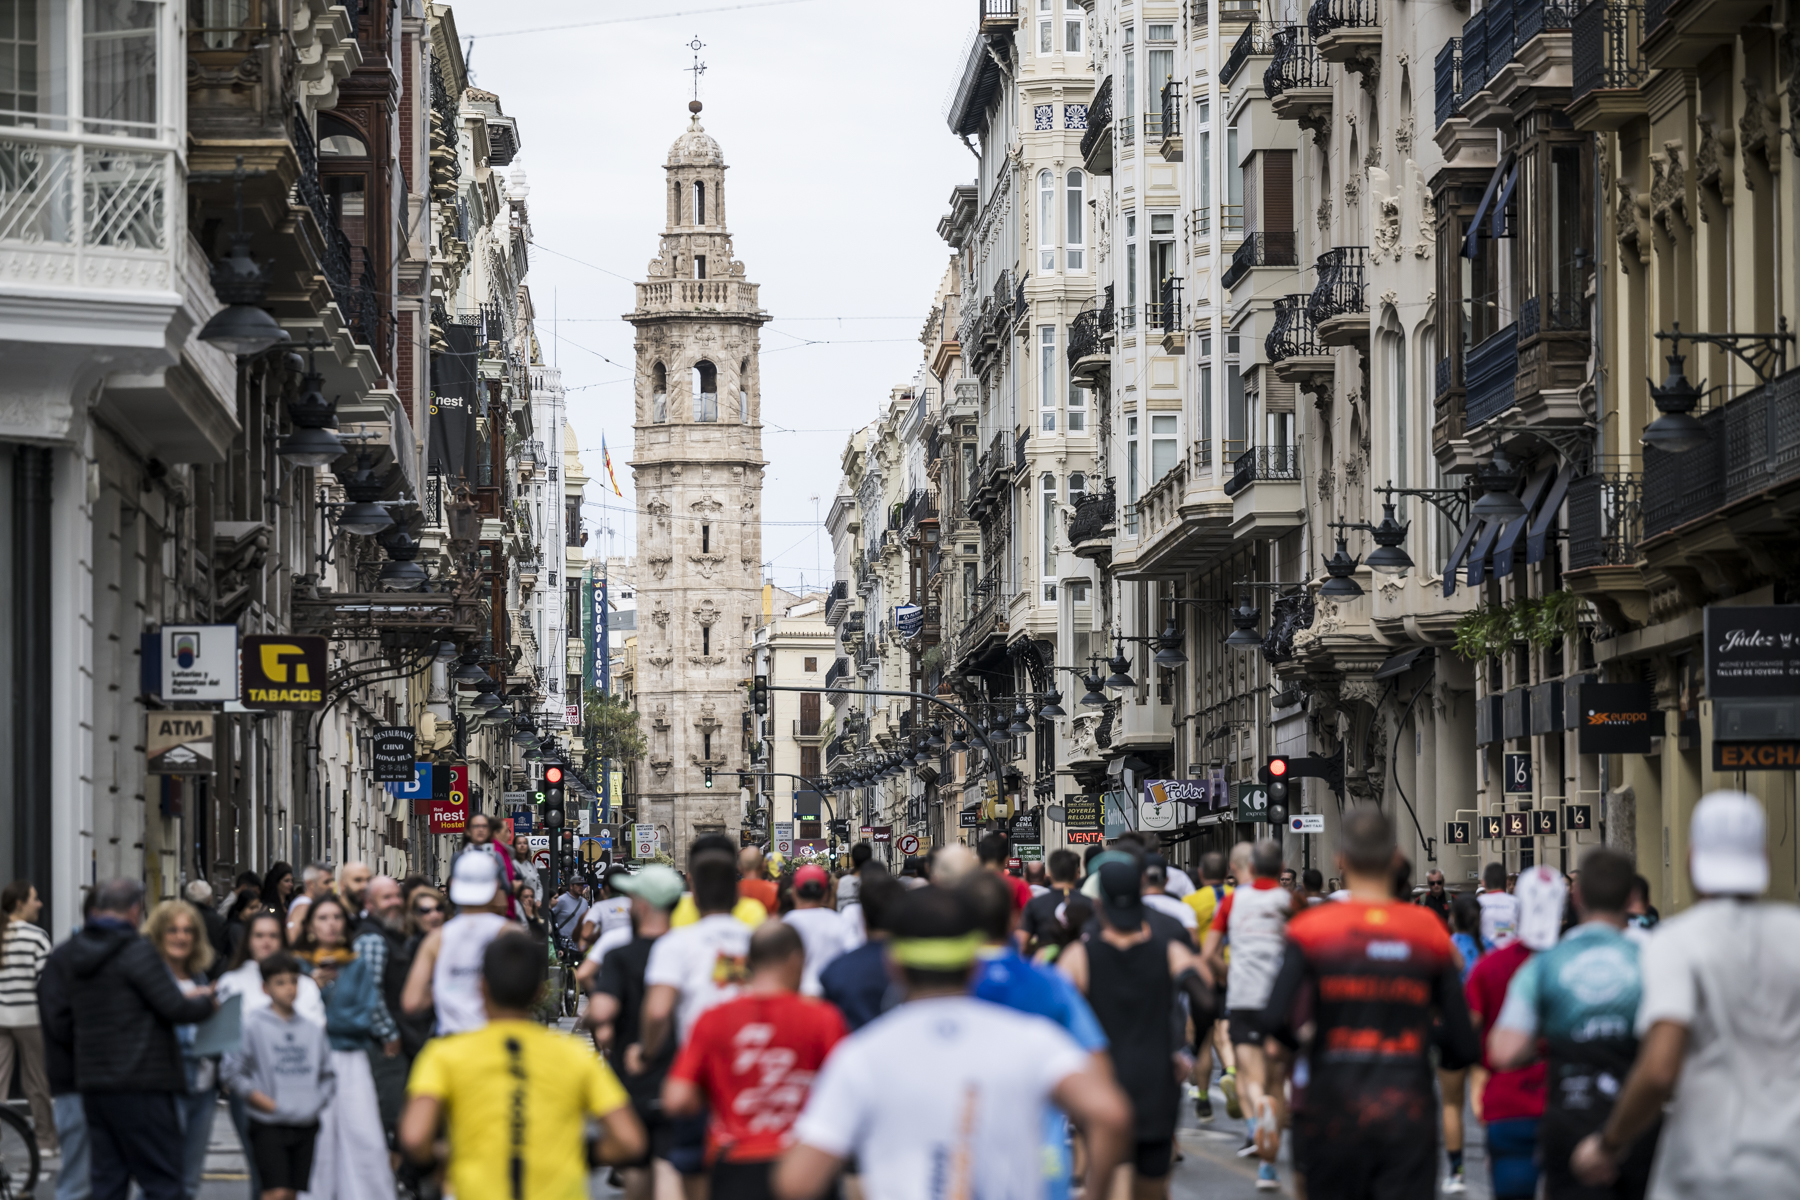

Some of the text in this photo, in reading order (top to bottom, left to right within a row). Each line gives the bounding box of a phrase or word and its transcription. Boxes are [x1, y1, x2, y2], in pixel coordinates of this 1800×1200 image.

[436, 396, 463, 407] nest
[248, 689, 322, 702] TABACOS
[1610, 712, 1647, 723] europa
[158, 719, 203, 736] ATM
[373, 729, 414, 741] RESTAURANTE
[382, 743, 404, 751] CHINO
[375, 753, 412, 762] RONG HUA
[1512, 755, 1527, 783] 16
[1162, 780, 1204, 799] Folder
[434, 809, 465, 821] nest
[1067, 806, 1096, 814] JOYERÍA
[1573, 806, 1585, 824] 16
[1488, 817, 1499, 834] 16
[1510, 814, 1522, 830] 16
[1539, 811, 1551, 829] 16
[1068, 832, 1104, 843] VENTA
[1453, 823, 1464, 839] 16
